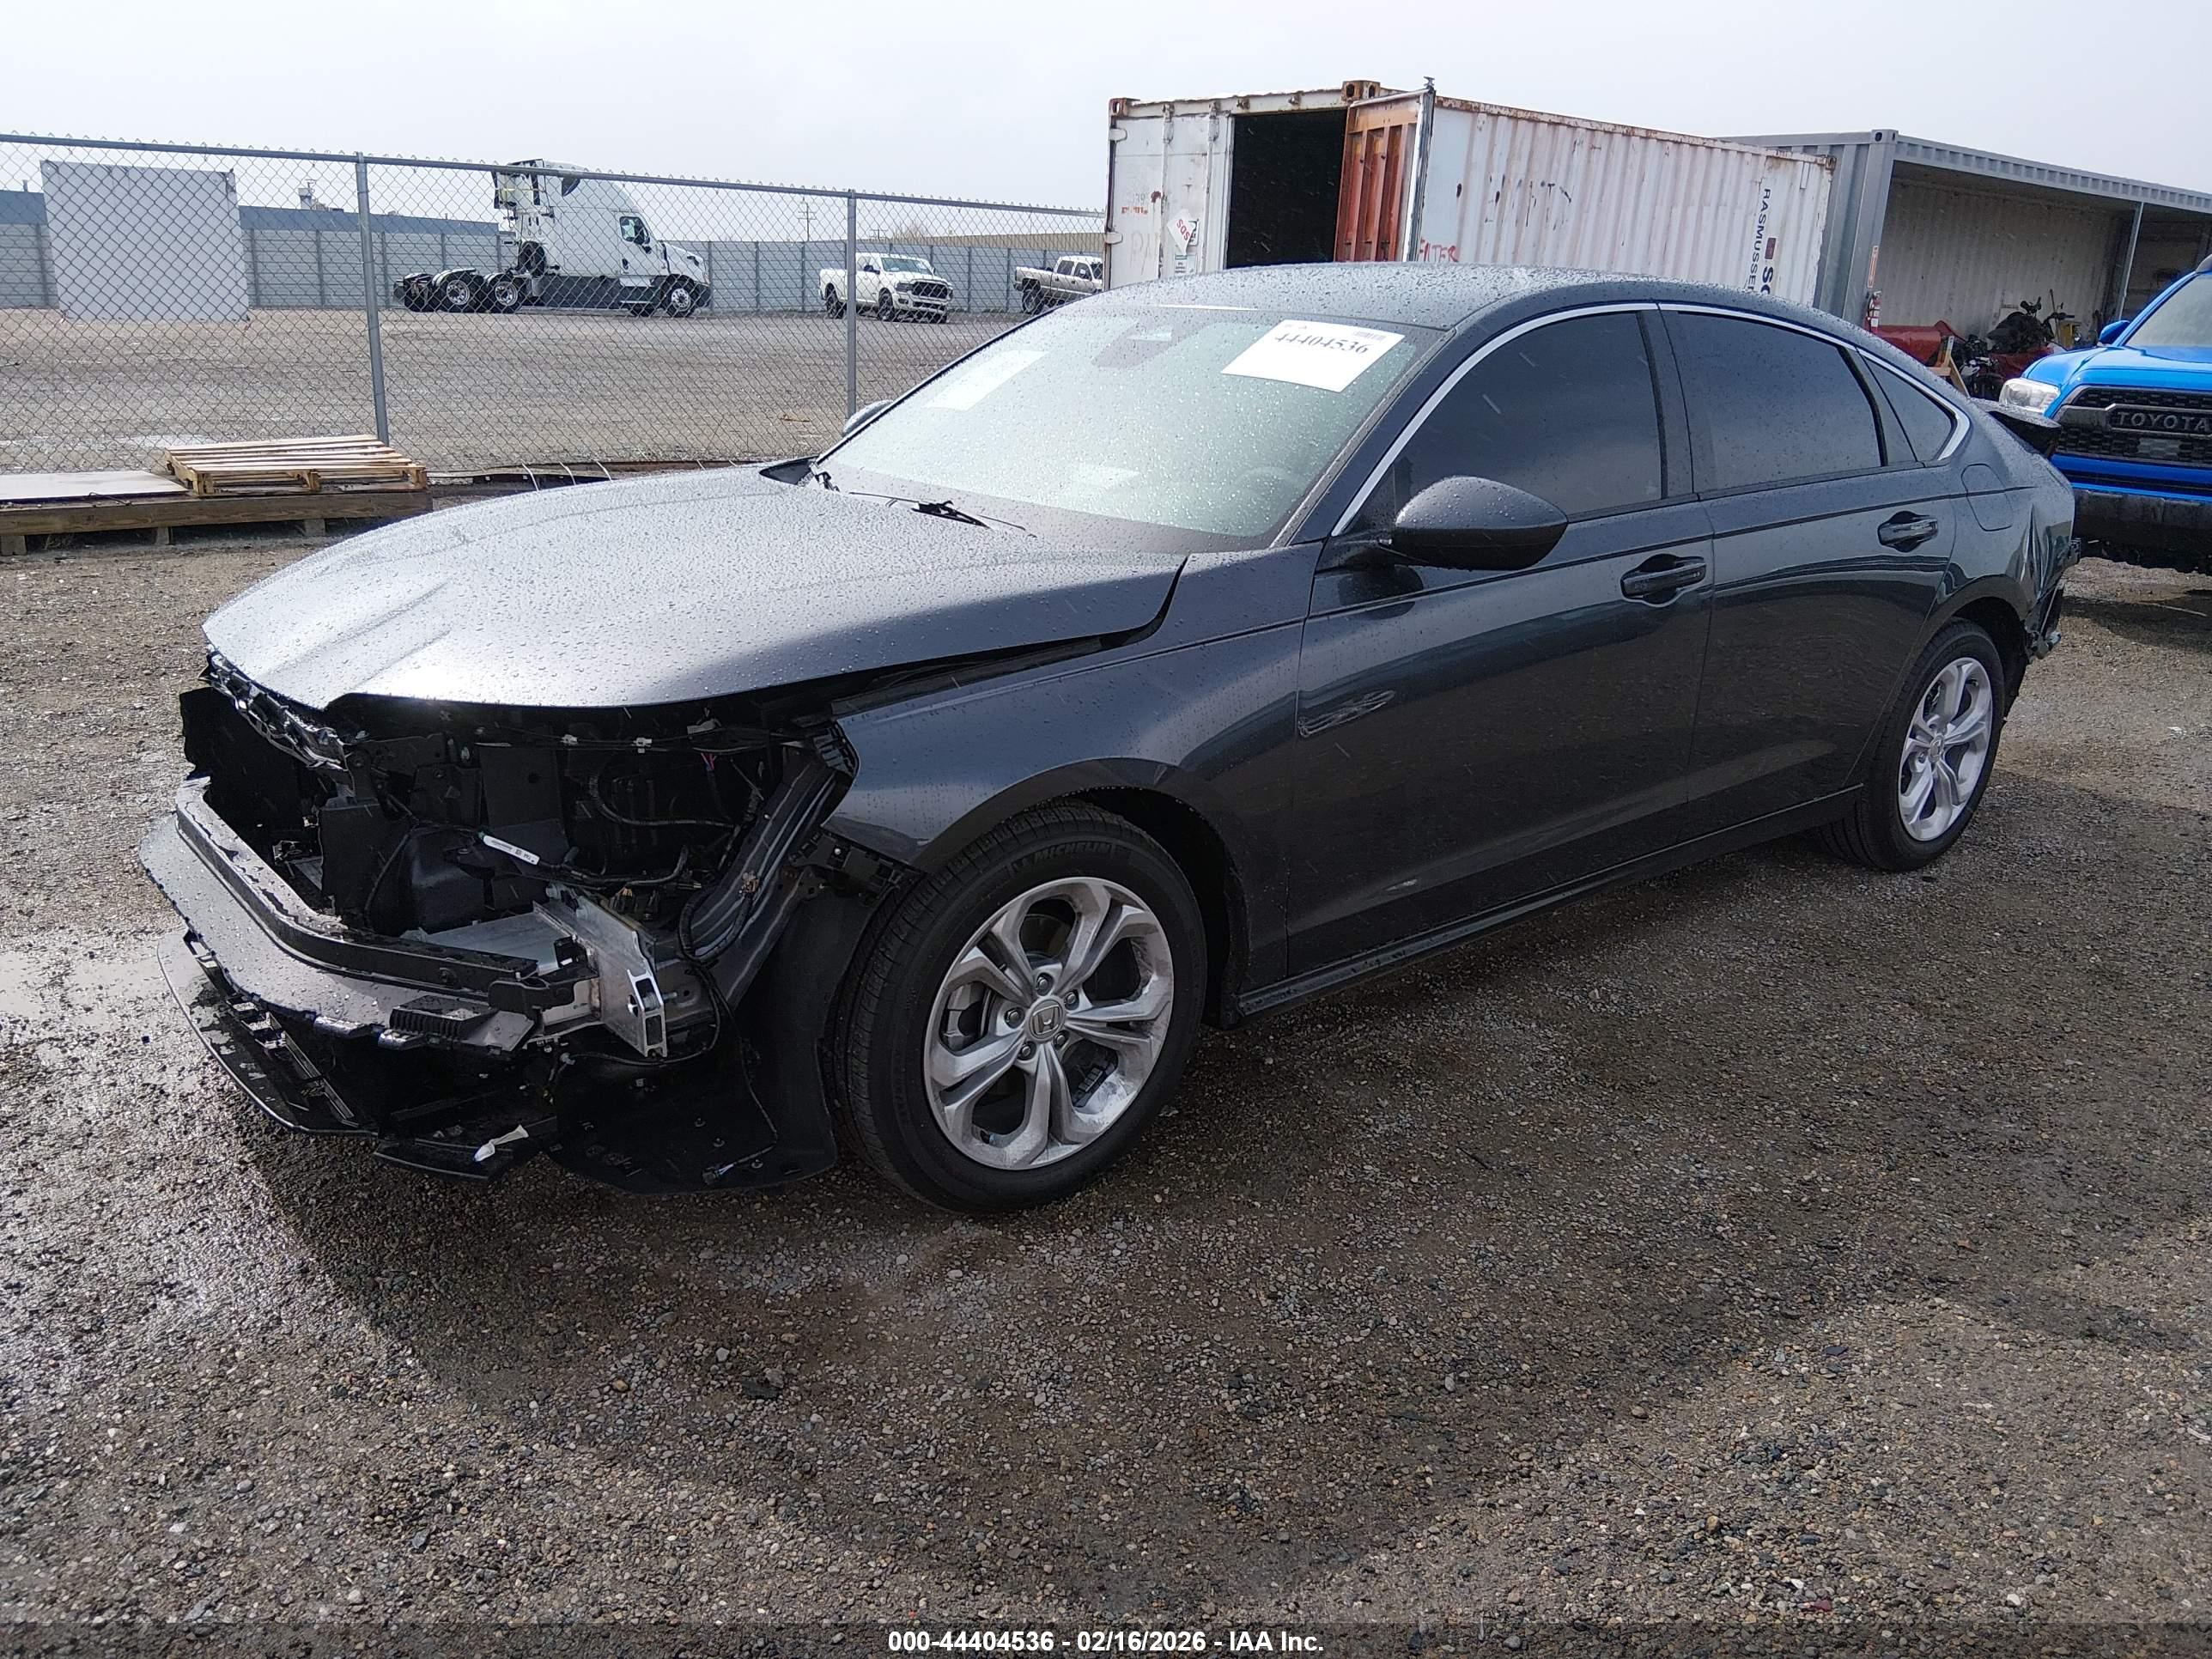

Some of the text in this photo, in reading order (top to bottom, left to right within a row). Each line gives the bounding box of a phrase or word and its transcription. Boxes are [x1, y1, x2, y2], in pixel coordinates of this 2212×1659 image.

[1275, 333, 1372, 354] 44404536
[2118, 411, 2211, 432] TOYOTA
[1036, 842, 1110, 861] MICHELIN
